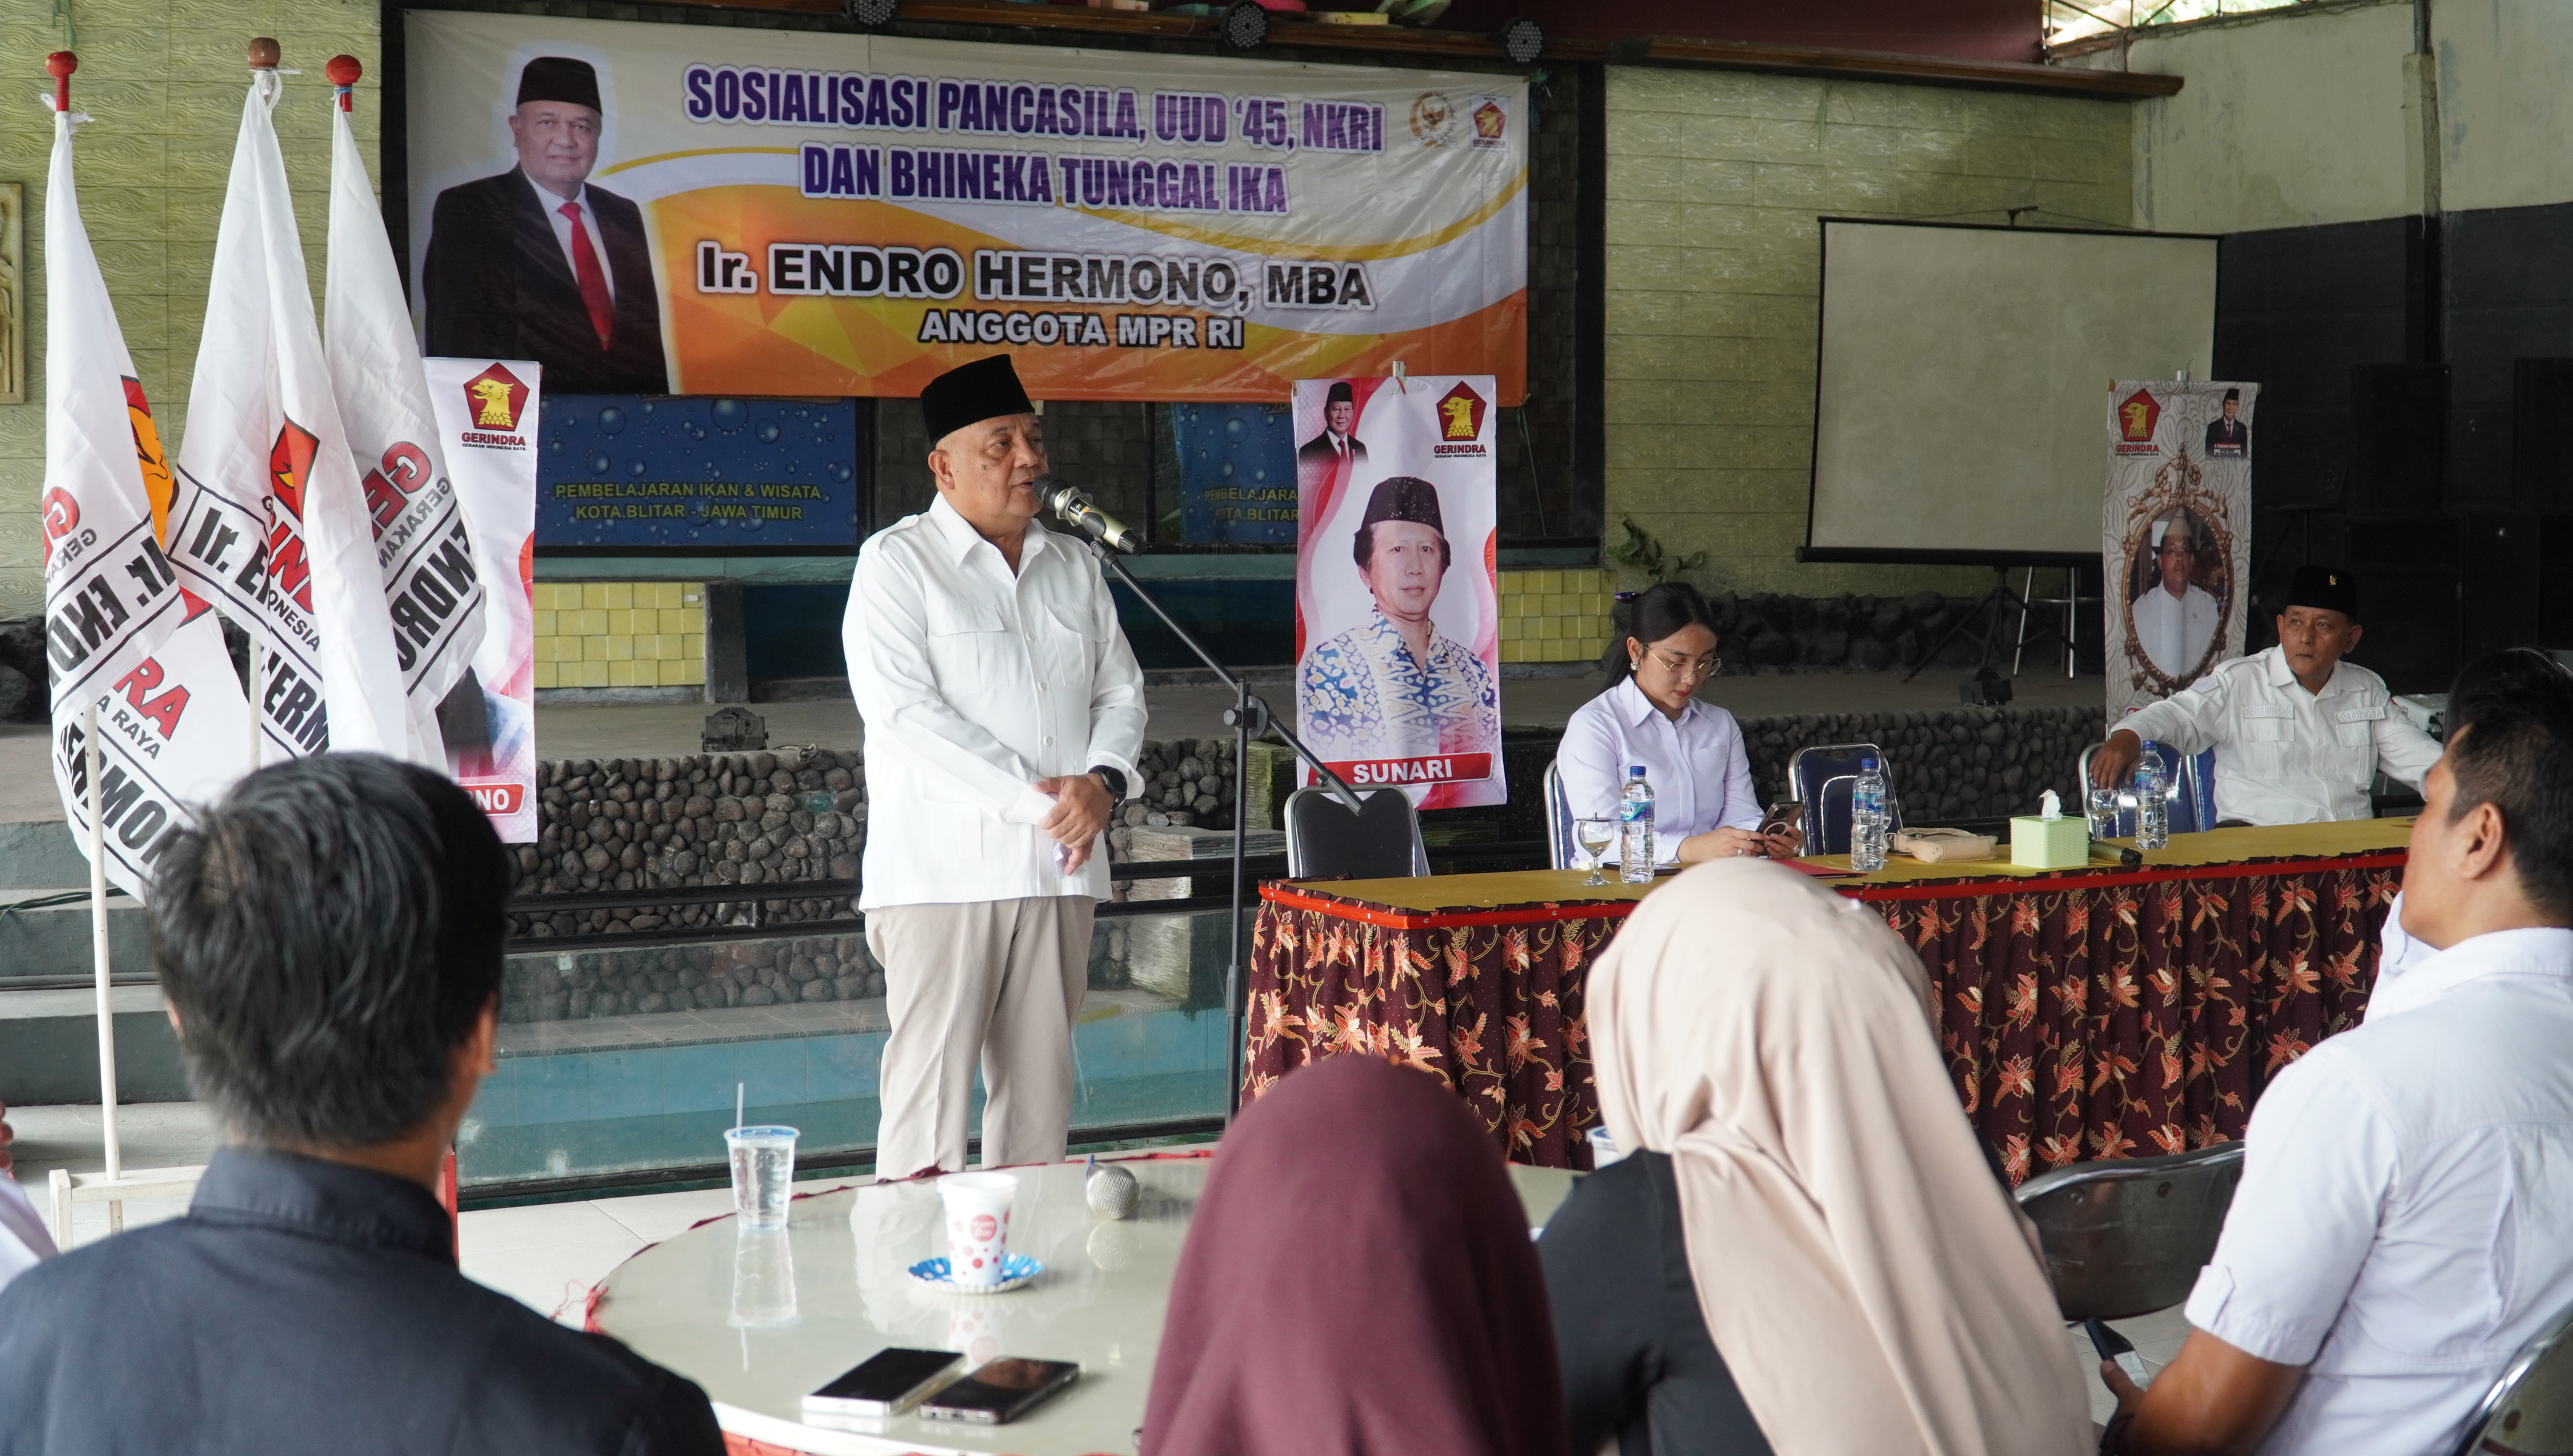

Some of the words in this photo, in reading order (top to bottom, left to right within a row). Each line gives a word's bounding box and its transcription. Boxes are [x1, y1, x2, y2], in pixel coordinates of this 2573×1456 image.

[687, 68, 927, 128] SOSIALISASI
[939, 83, 1146, 144] PANCASILA,
[1155, 94, 1226, 143] UUD
[1303, 103, 1381, 150] NKRI
[804, 146, 879, 195] DAN
[891, 150, 1052, 202] BHINEKA
[1060, 158, 1220, 210] TUNGGAL
[1229, 166, 1287, 212] IKA
[702, 246, 752, 288] Ir.
[774, 249, 959, 294] ENDRO
[980, 255, 1249, 313] HERMONO,
[1267, 265, 1372, 306] MBA
[921, 312, 1107, 344] ANGGOTA
[1118, 317, 1197, 346] MPR
[1208, 319, 1243, 347] RI
[462, 432, 526, 445] GERINDRA
[1434, 445, 1486, 454] GERINDRA
[555, 484, 693, 497] PEMBELAJARAN
[699, 484, 738, 496] IKAN
[745, 484, 755, 497] &
[760, 485, 821, 499] WISATA
[1205, 488, 1297, 502] PEMBELAJARA
[576, 505, 622, 519] KOTA
[627, 504, 685, 518] BLITAR
[702, 505, 747, 517] JAWA
[752, 506, 802, 519] TIMUR
[189, 507, 239, 574] Ir.
[268, 589, 320, 653] ONESIA
[2339, 709, 2382, 721] GERINDRA
[112, 709, 161, 760] RAYA
[1353, 759, 1453, 783] SUNARI
[465, 789, 509, 810] NO
